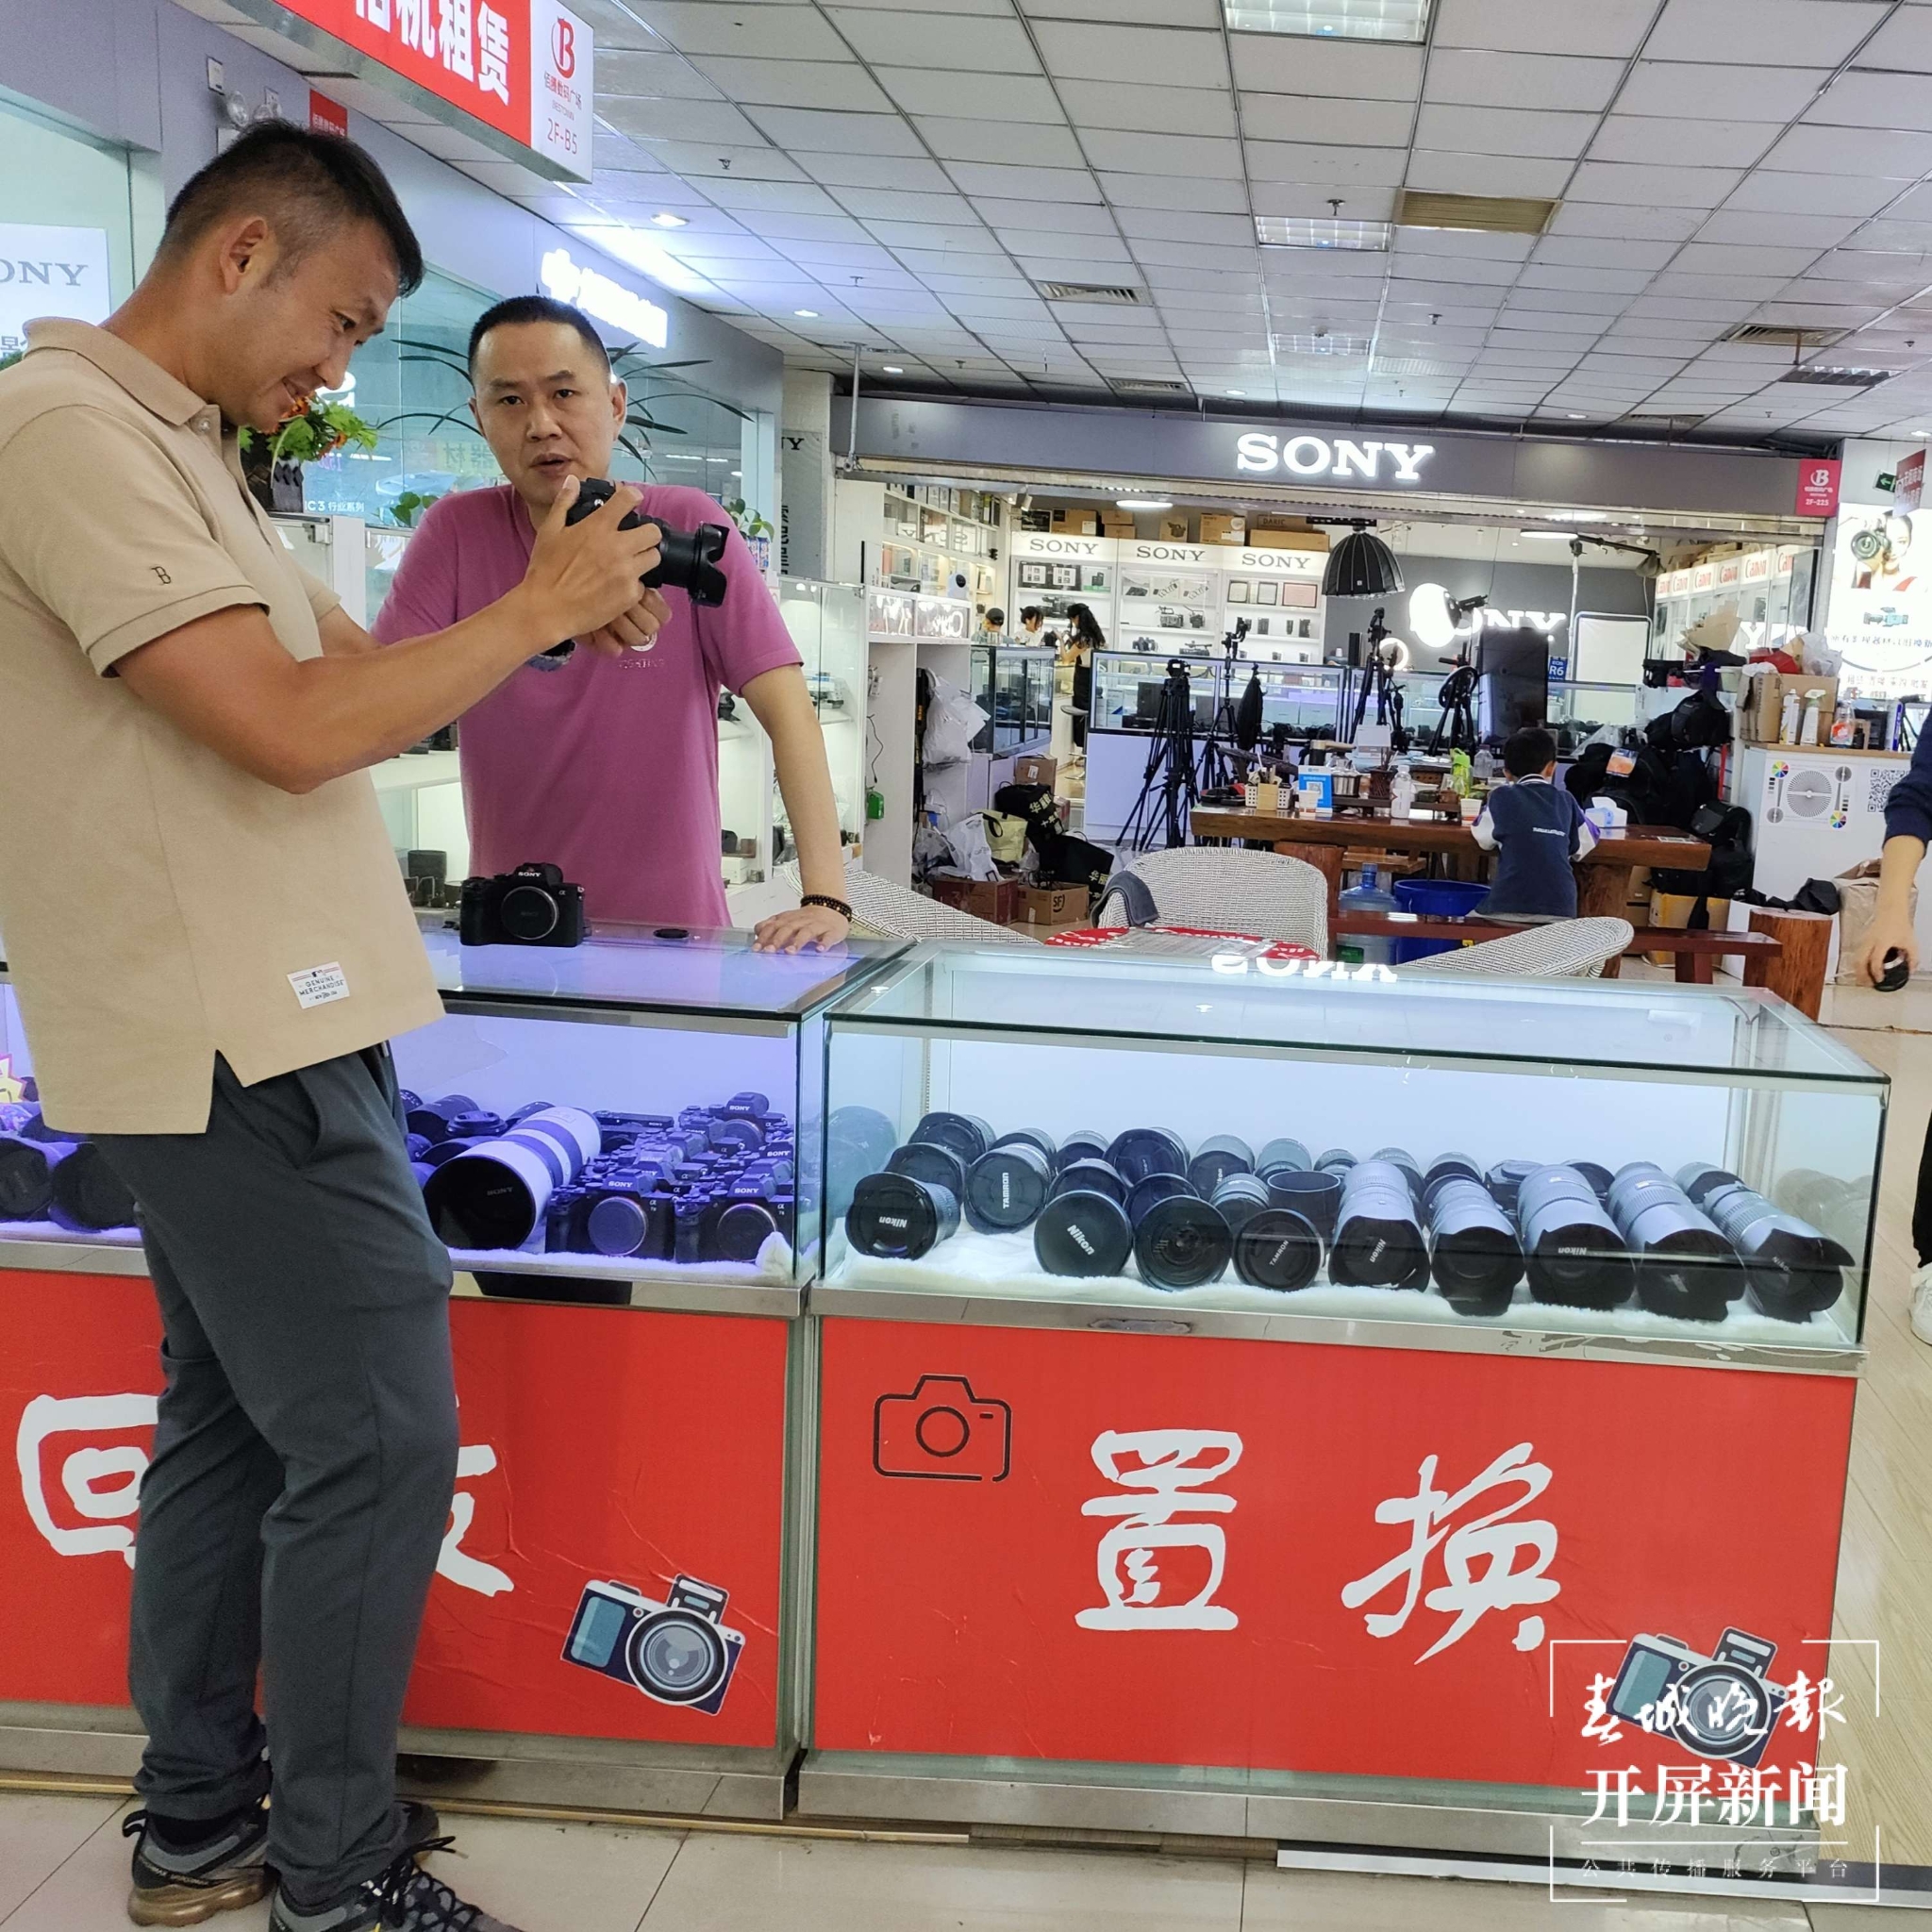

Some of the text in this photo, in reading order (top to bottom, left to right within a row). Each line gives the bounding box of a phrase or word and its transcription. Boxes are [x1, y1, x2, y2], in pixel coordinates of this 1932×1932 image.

[547, 118, 578, 155] 2F-B5
[1237, 432, 1435, 480] SONY
[318, 500, 325, 511] 3
[327, 501, 365, 512] 行业系列
[1029, 538, 1099, 555] SONY
[1136, 545, 1206, 562] SONY
[1241, 553, 1311, 570] SONY
[1745, 558, 1767, 579] Canon
[150, 565, 172, 586] B
[1694, 570, 1712, 589] Canon
[1720, 565, 1739, 584] Canon
[1549, 665, 1564, 676] R6
[298, 979, 344, 996] MERCHANDISE
[305, 974, 335, 988] GENUINE
[487, 1186, 513, 1196] SONY
[608, 1180, 633, 1189] SONY
[879, 1215, 908, 1228] Nikon
[1067, 1224, 1095, 1256] Nikon
[1269, 1240, 1290, 1267] TAMRON
[1370, 1239, 1387, 1263] Nikon
[1557, 1247, 1588, 1256] Nikon
[1075, 1428, 1561, 1665] 置换
